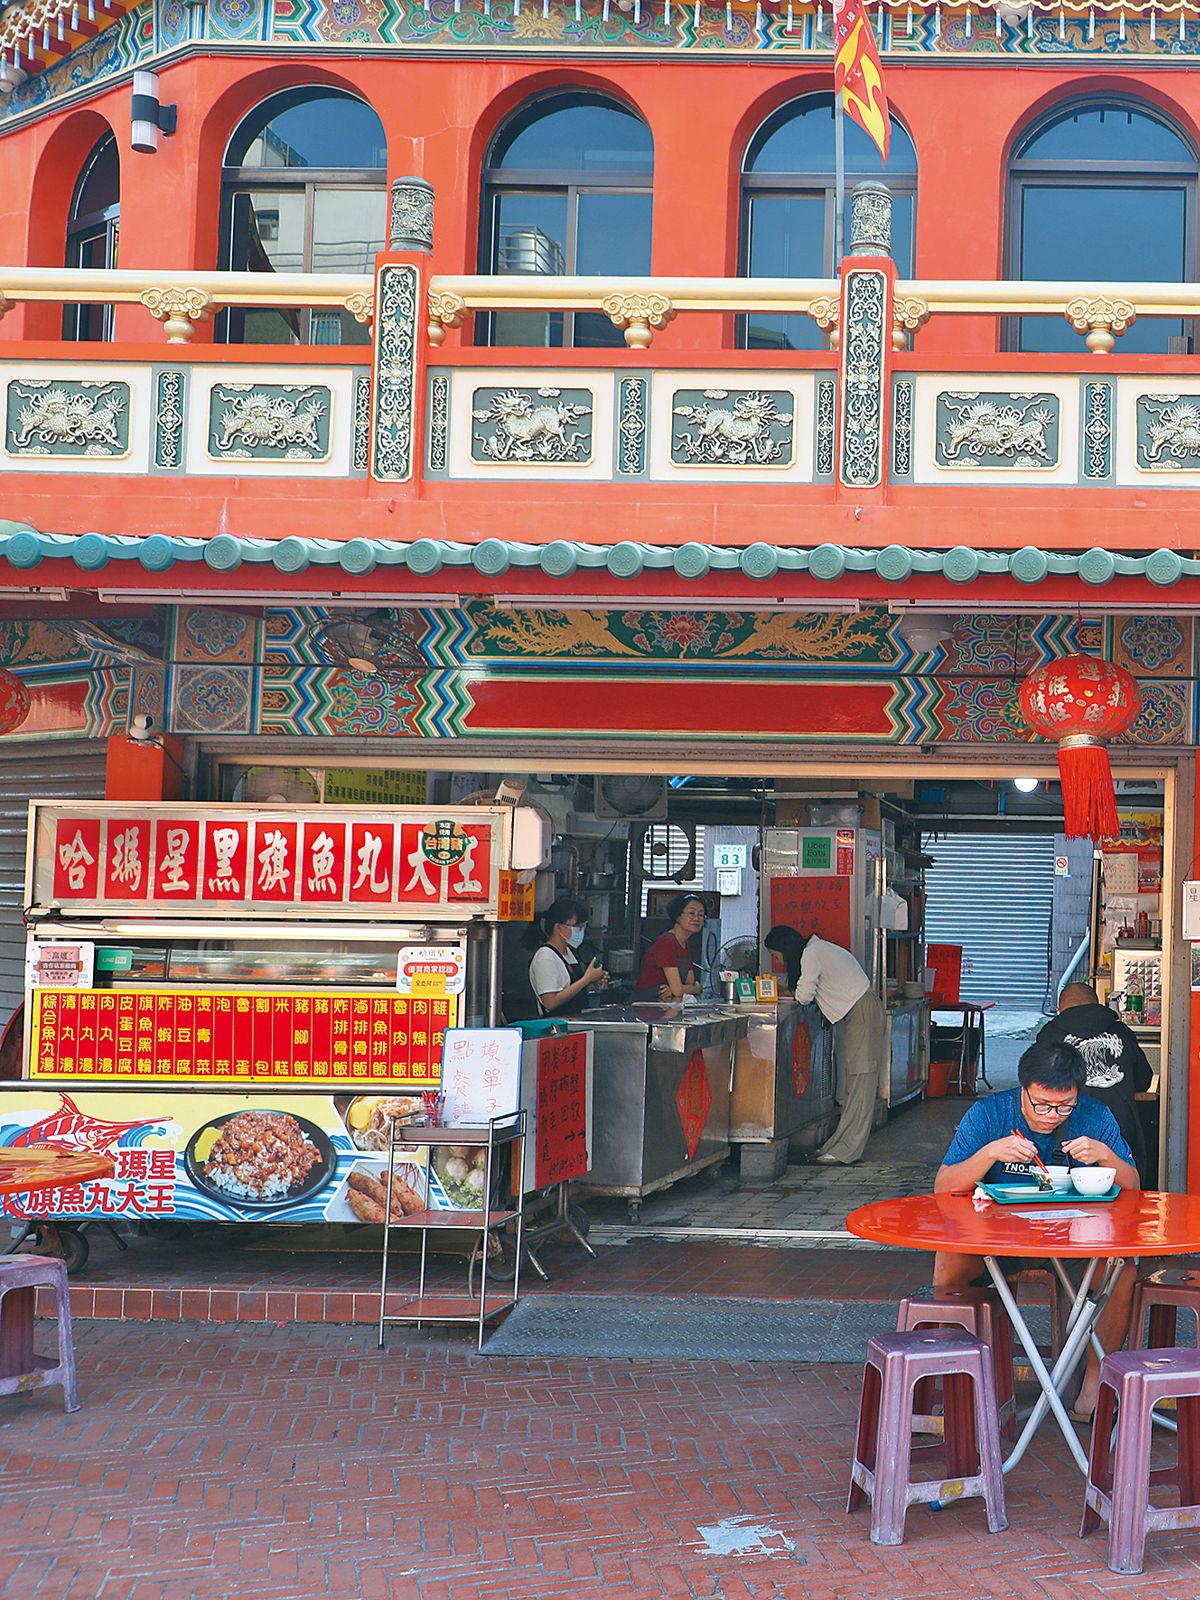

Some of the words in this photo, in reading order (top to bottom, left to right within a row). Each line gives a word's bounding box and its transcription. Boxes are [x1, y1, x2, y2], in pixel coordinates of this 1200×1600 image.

[58, 827, 484, 896] 哈瑪星黑旗魚丸大王
[721, 854, 740, 865] 83
[807, 841, 826, 849] Uber
[807, 849, 826, 857] Eats
[40, 995, 58, 1072] 綜合魚丸湯
[59, 995, 77, 1072] 清丸湯
[79, 996, 96, 1072] 蝦丸湯
[98, 996, 115, 1073] 肉丸湯
[118, 996, 134, 1073] 皮蛋豆腐
[137, 996, 153, 1073] 旗魚黑輪
[156, 996, 173, 1074] 炸蝦捲
[176, 997, 192, 1074] 油豆腐
[196, 997, 212, 1074] 燙青菜
[215, 998, 231, 1075] 泡菜
[235, 998, 250, 1075] 魯蛋
[255, 998, 270, 1075] 割包
[274, 999, 290, 1075] 米糕
[294, 999, 310, 1076] 豬腳飯
[313, 999, 329, 1076] 豬腳
[333, 999, 349, 1076] 炸排骨飯
[352, 1000, 368, 1076] 滷排骨飯
[372, 1000, 388, 1076] 旗魚排飯
[392, 1000, 407, 1077] 魯肉飯
[411, 1000, 427, 1077] 肉燥飯
[26, 1183, 175, 1213] 旗魚丸大王
